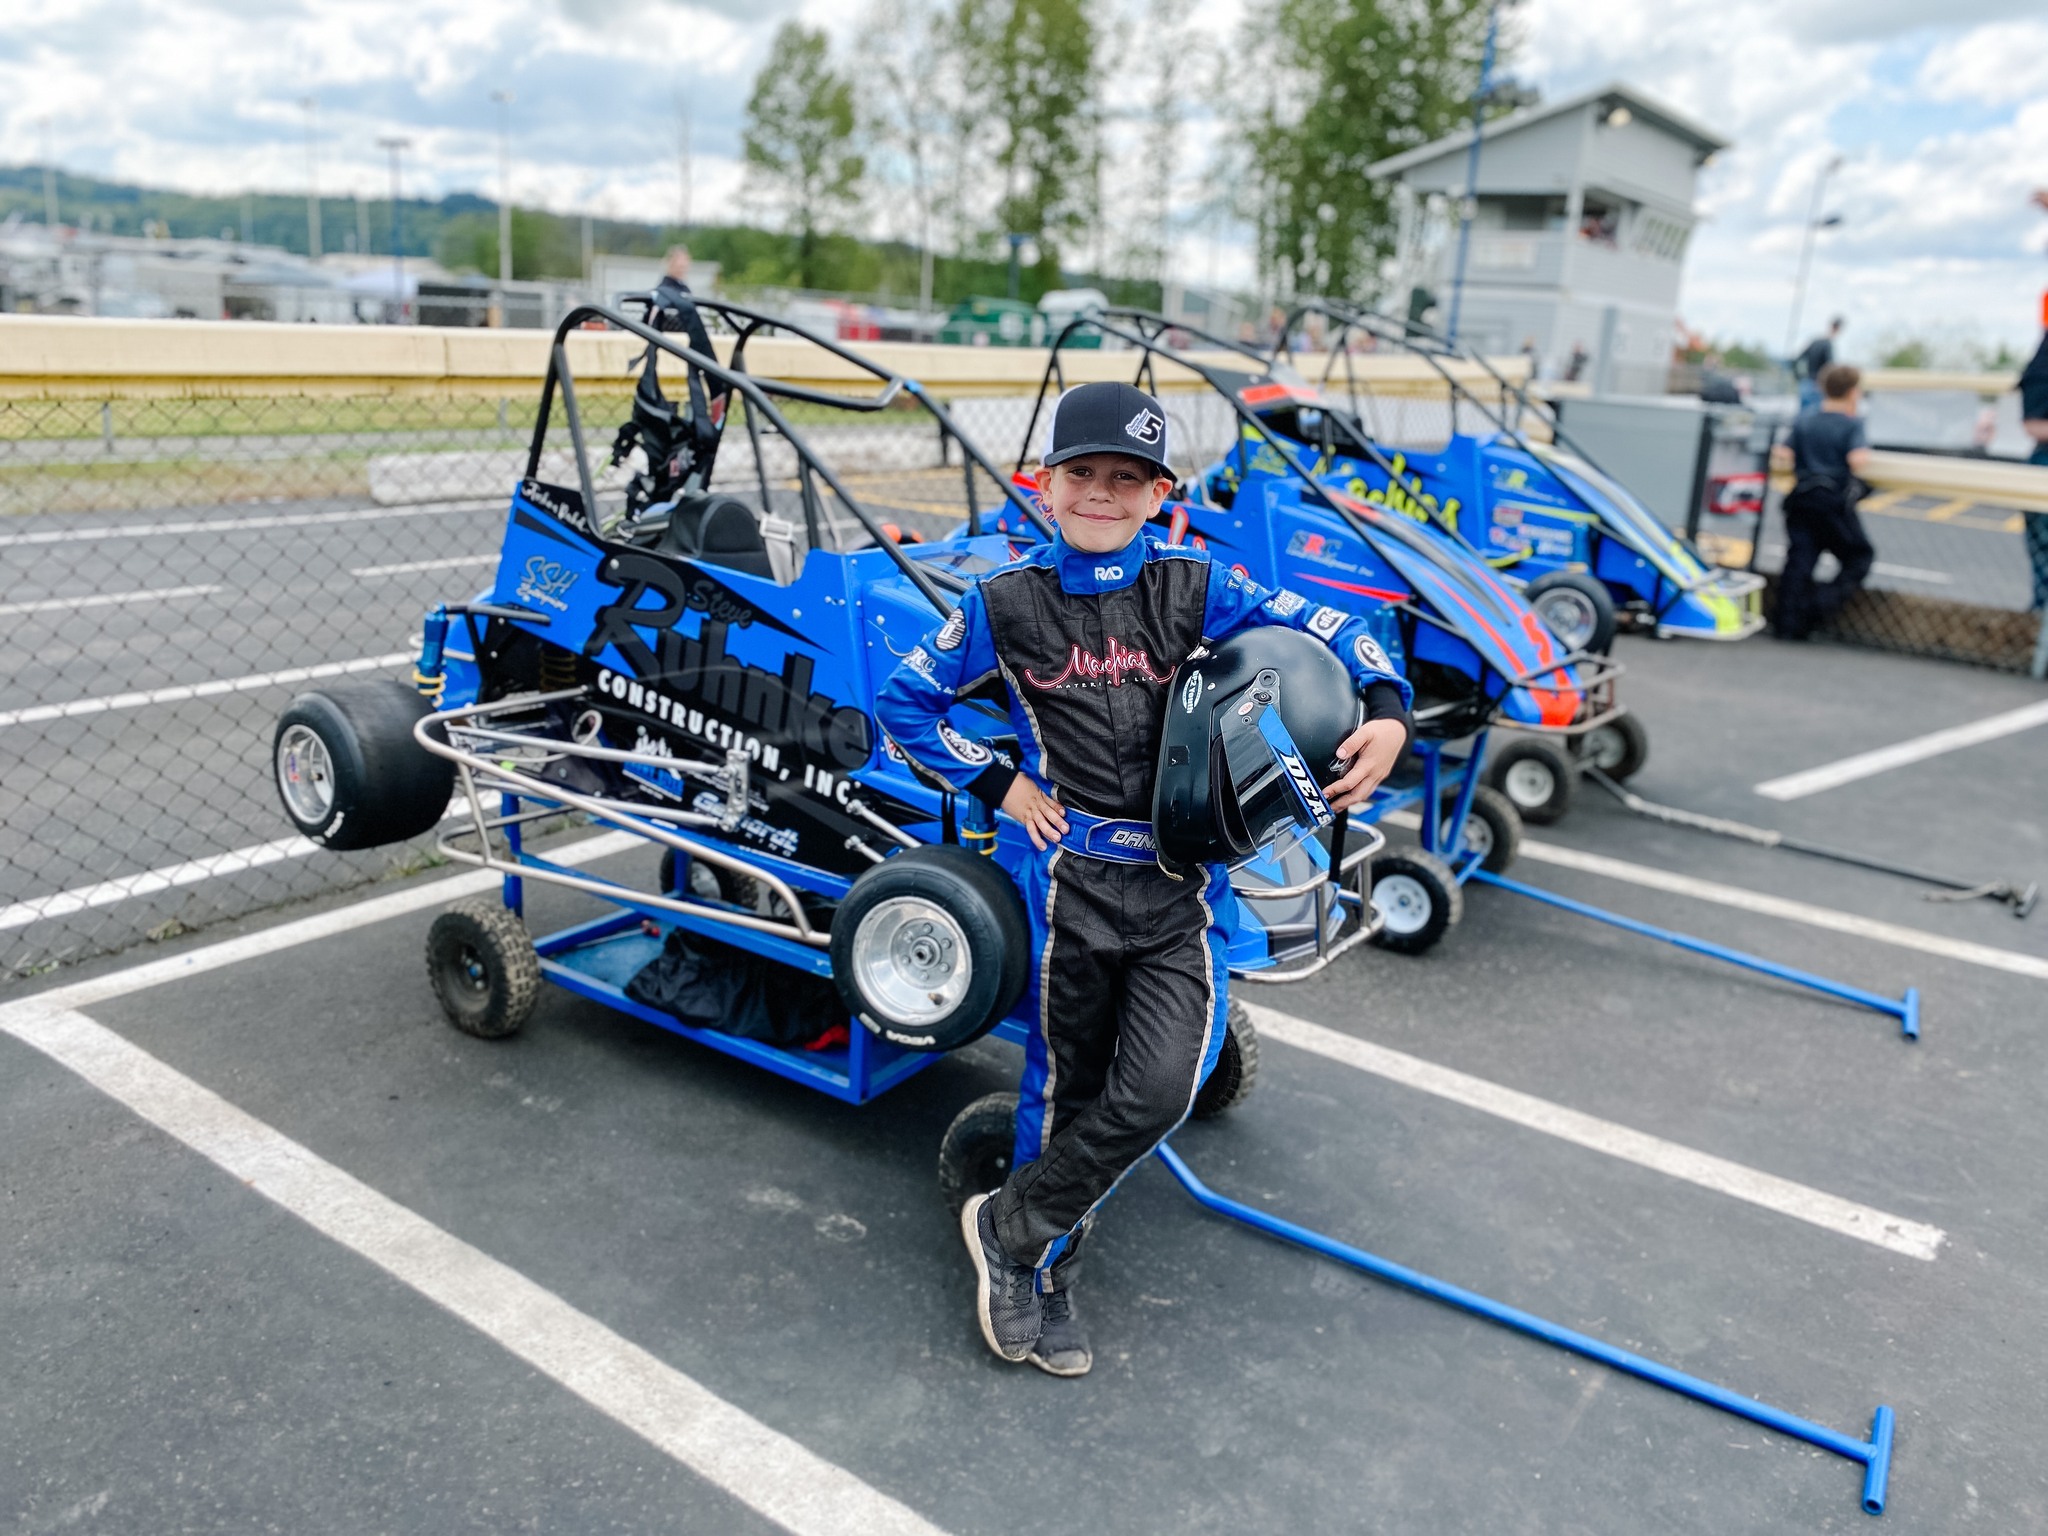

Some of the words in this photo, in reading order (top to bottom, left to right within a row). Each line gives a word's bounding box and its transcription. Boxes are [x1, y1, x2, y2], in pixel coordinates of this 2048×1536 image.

[1135, 412, 1164, 444] 5
[1094, 566, 1124, 581] RAD
[686, 579, 752, 630] Steve
[583, 552, 873, 768] Ruhnke
[1108, 828, 1158, 849] DAN
